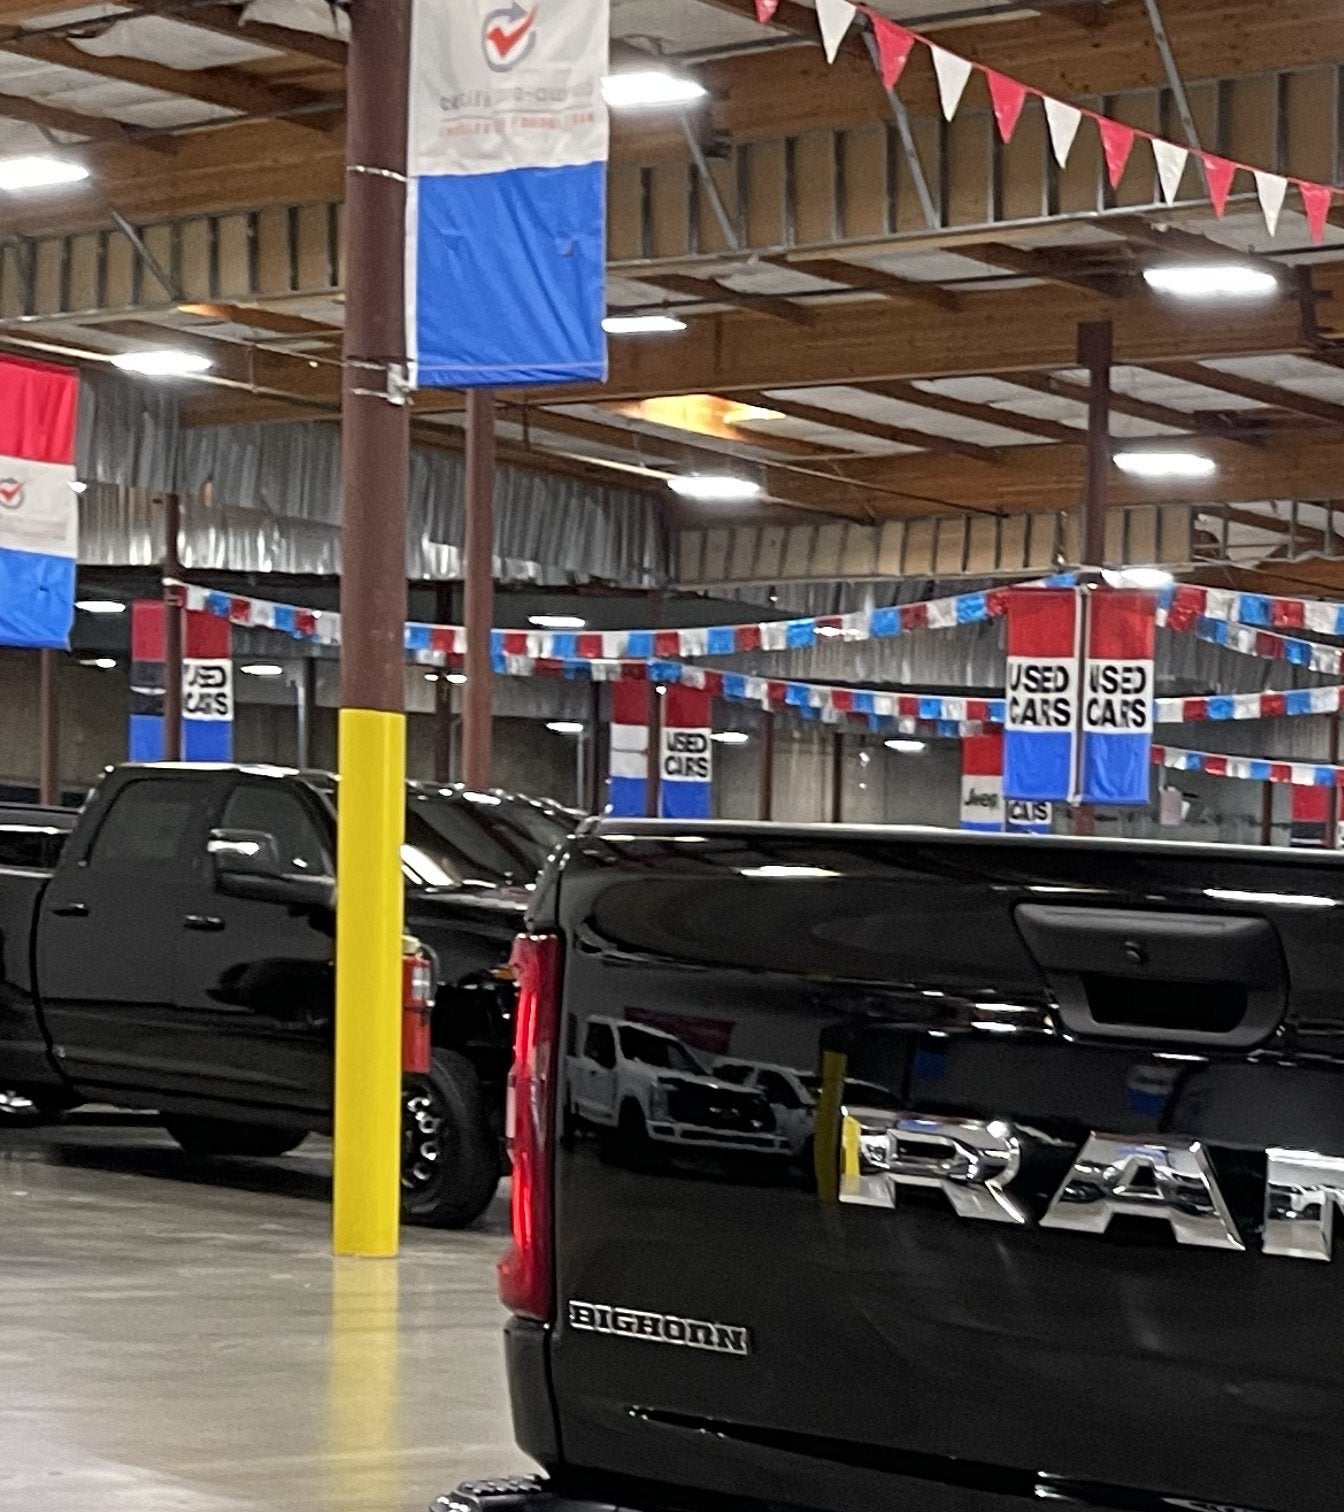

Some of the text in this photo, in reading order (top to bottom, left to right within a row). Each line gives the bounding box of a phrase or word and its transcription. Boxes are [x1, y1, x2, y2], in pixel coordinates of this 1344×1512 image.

[1009, 663, 1069, 693] USED
[1090, 665, 1146, 694] USED
[1009, 696, 1071, 727] CARS
[1086, 697, 1146, 728] CARS
[568, 1300, 748, 1356] BIGHORN
